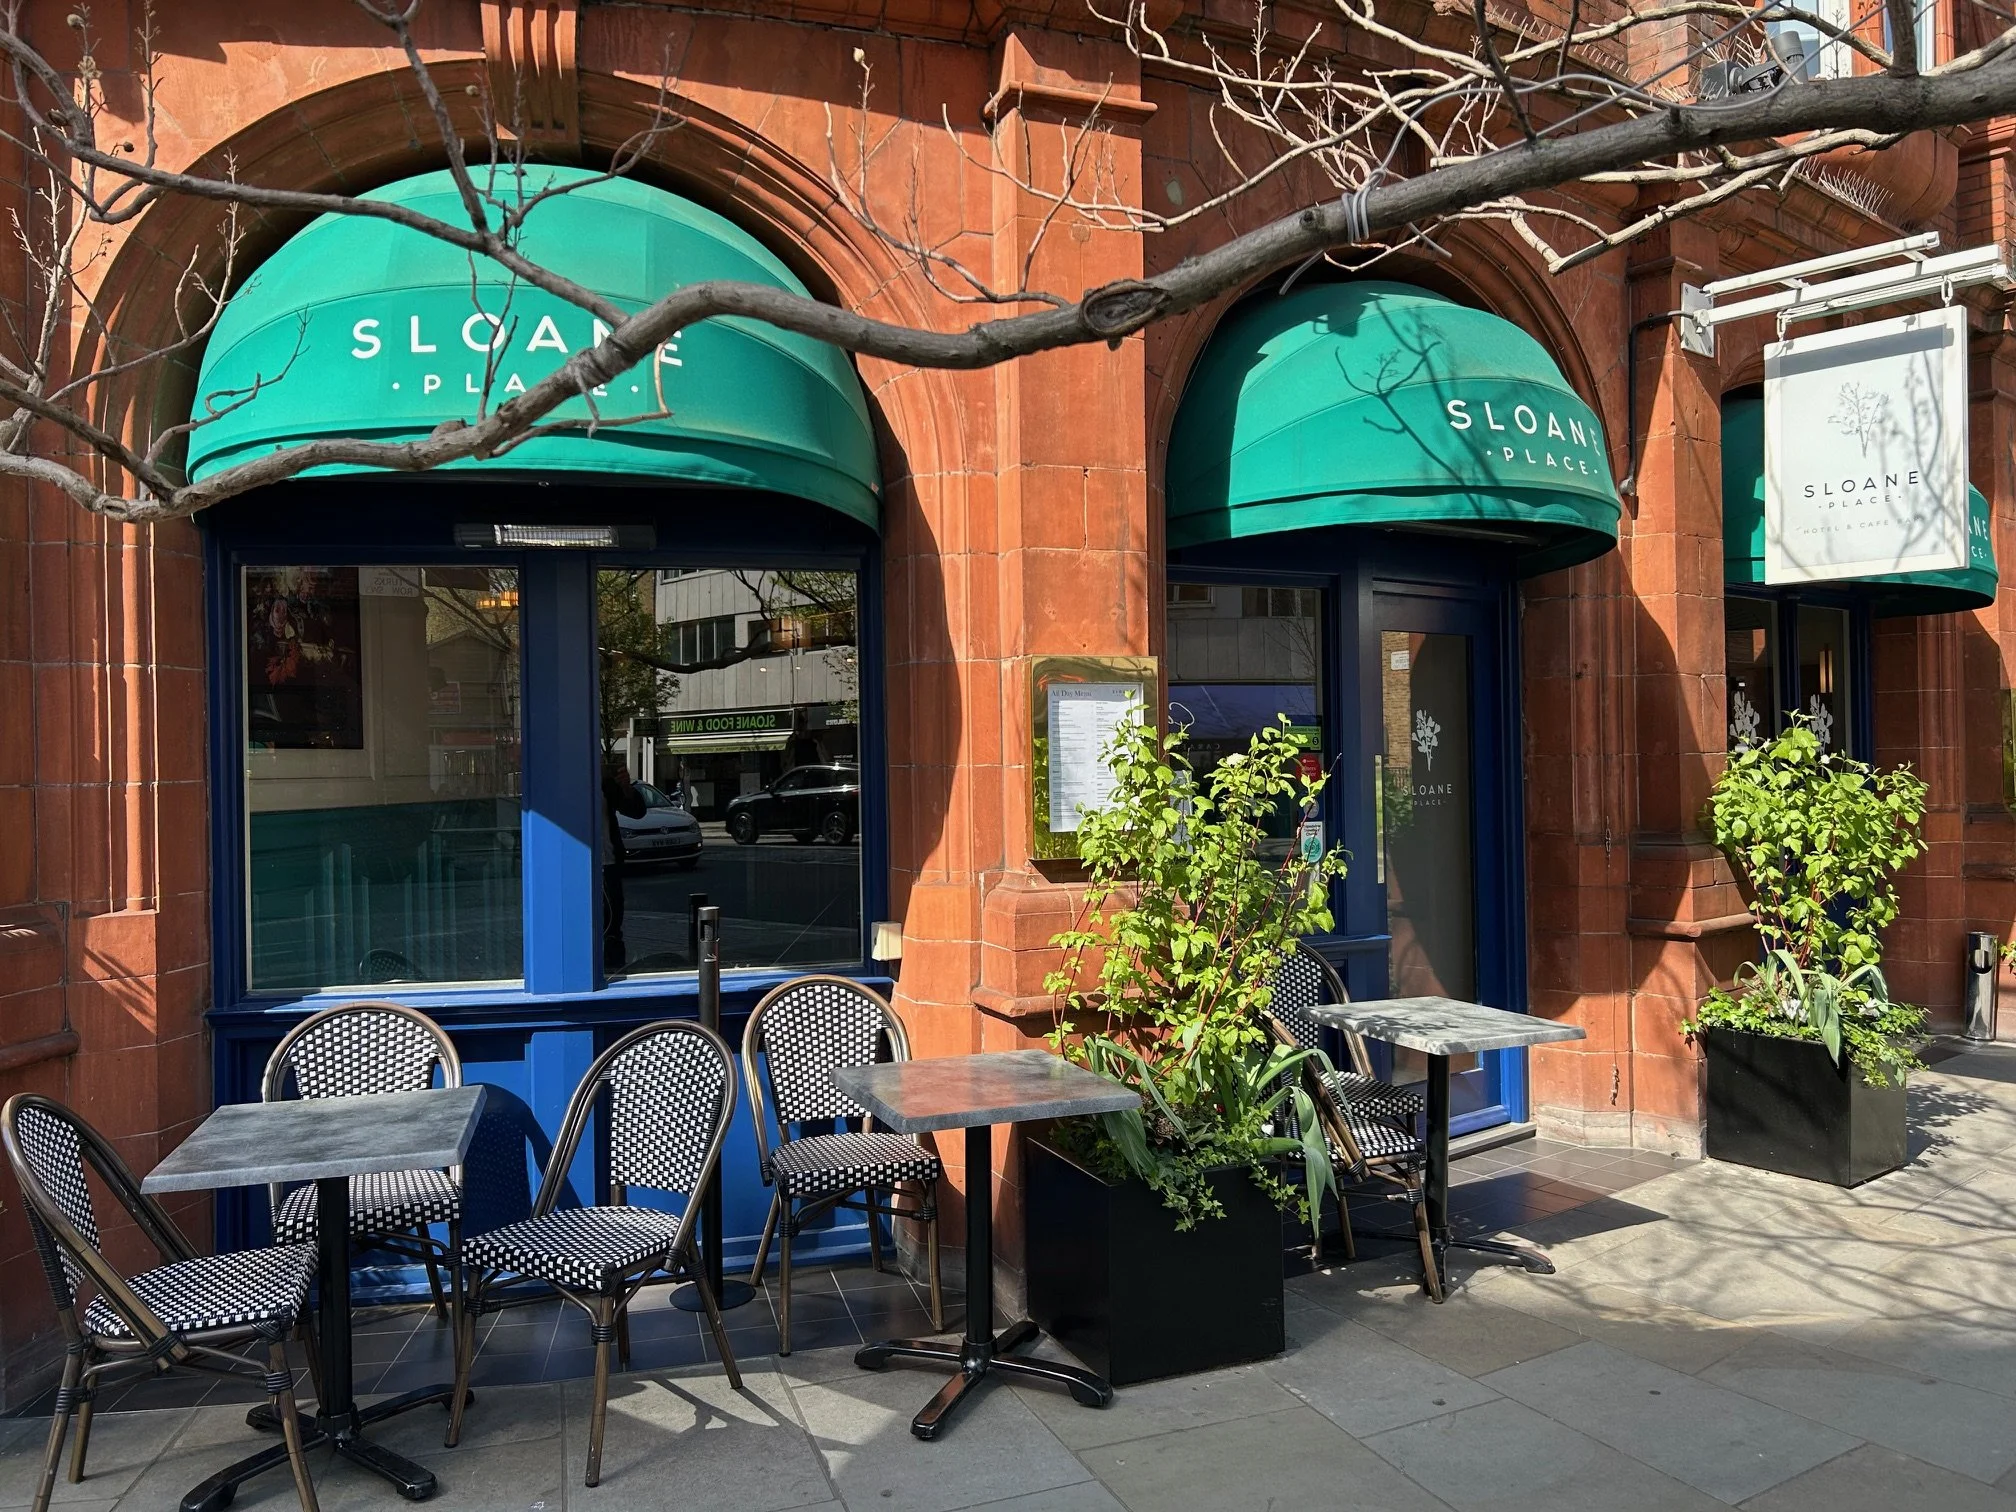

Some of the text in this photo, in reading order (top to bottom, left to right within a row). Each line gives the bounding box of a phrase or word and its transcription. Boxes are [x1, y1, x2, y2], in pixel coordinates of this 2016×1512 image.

[1447, 399, 1601, 457] SLOANE
[1503, 446, 1589, 475] PLACE
[1803, 470, 1919, 498] SLOANE
[1828, 494, 1891, 509] PLACE
[1803, 526, 1840, 535] HOTEL
[1846, 523, 1852, 531] &
[1061, 690, 1073, 698] Day
[1402, 784, 1452, 796] SLOANE
[1413, 799, 1441, 807] PLACE
